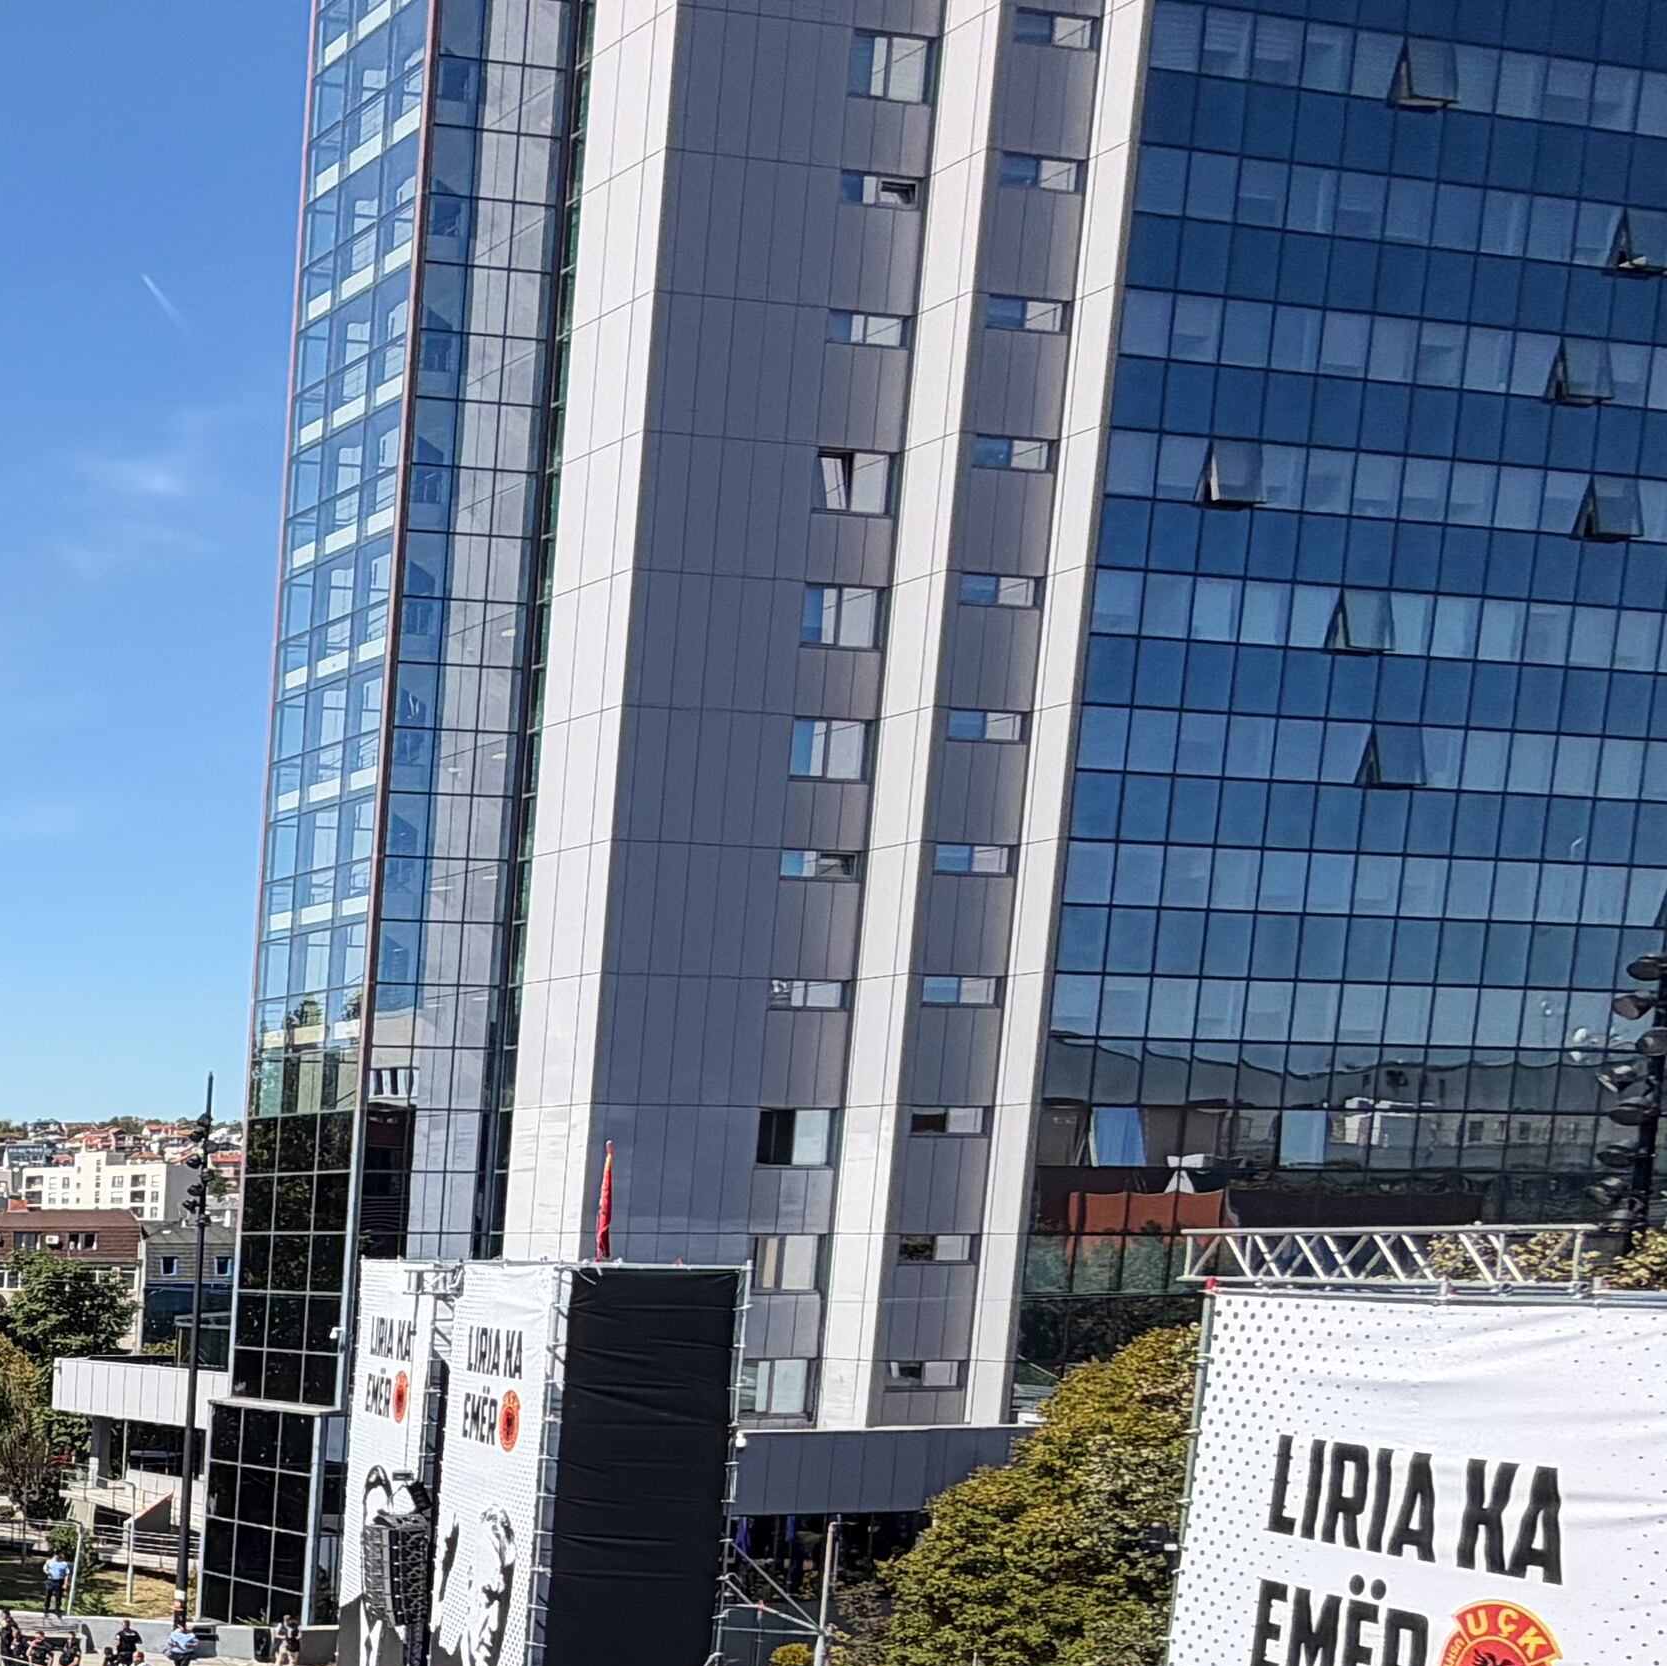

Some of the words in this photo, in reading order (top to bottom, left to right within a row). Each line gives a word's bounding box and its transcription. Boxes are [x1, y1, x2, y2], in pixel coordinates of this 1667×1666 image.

[467, 1326, 500, 1377] LIRIA
[504, 1330, 523, 1380] KA
[462, 1385, 498, 1446] EMËR
[1267, 1434, 1436, 1563] LIRIA
[1457, 1458, 1563, 1585] KA
[1467, 1609, 1547, 1660] UÇK
